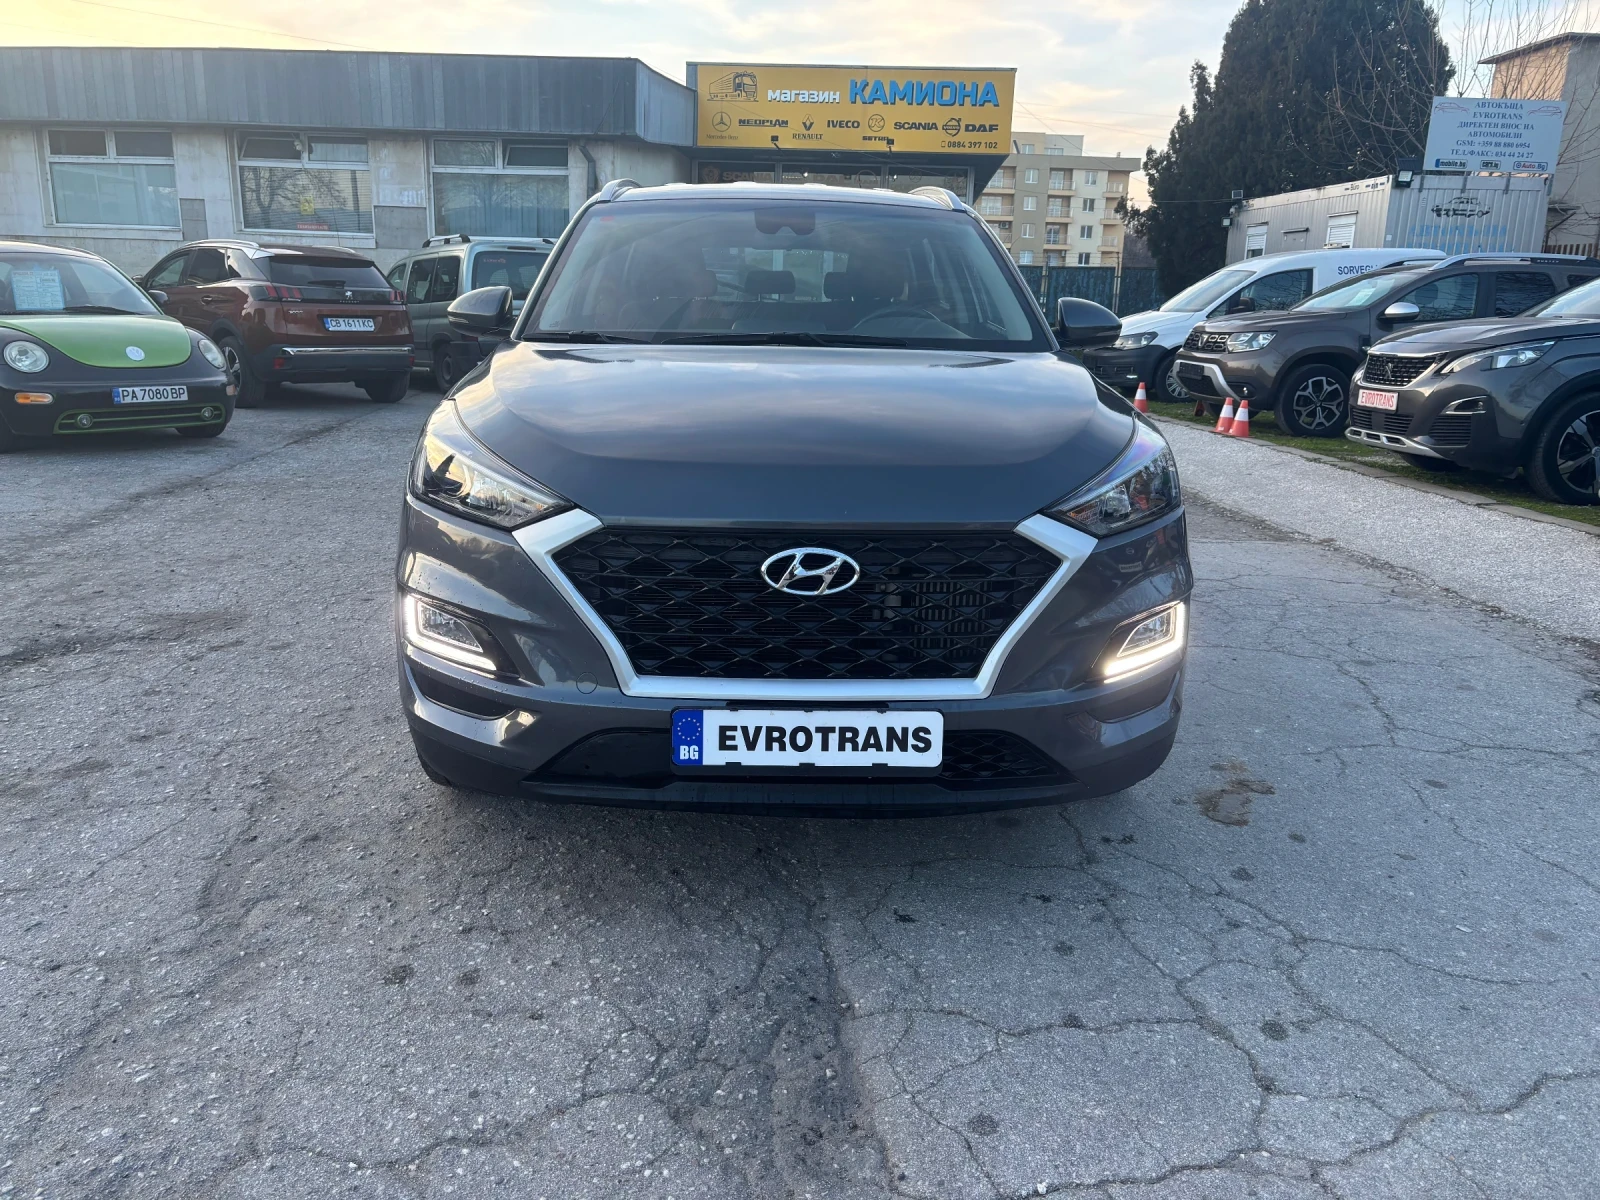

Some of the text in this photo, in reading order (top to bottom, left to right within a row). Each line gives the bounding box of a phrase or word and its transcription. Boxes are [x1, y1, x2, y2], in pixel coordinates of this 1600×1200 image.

[767, 79, 1000, 107] магазин КАМИОНА
[1475, 101, 1524, 110] АВТОКЪЩА
[1472, 112, 1523, 120] EVROTRANS
[738, 118, 789, 128] NEOPLAN
[827, 119, 860, 129] IVECO
[893, 121, 939, 131] SCANIA
[964, 124, 999, 132] DAF
[1457, 120, 1499, 129] ДИРЕКТЕН
[1500, 122, 1522, 130] ВНОС
[792, 132, 823, 141] RENAULT
[1468, 131, 1523, 139] АВТОМОБИЛИ
[947, 141, 966, 149] 0884
[968, 141, 982, 149] 397
[1361, 391, 1395, 408] EVROTRANS
[718, 725, 932, 753] EVROTRANS
[679, 745, 699, 760] BG
